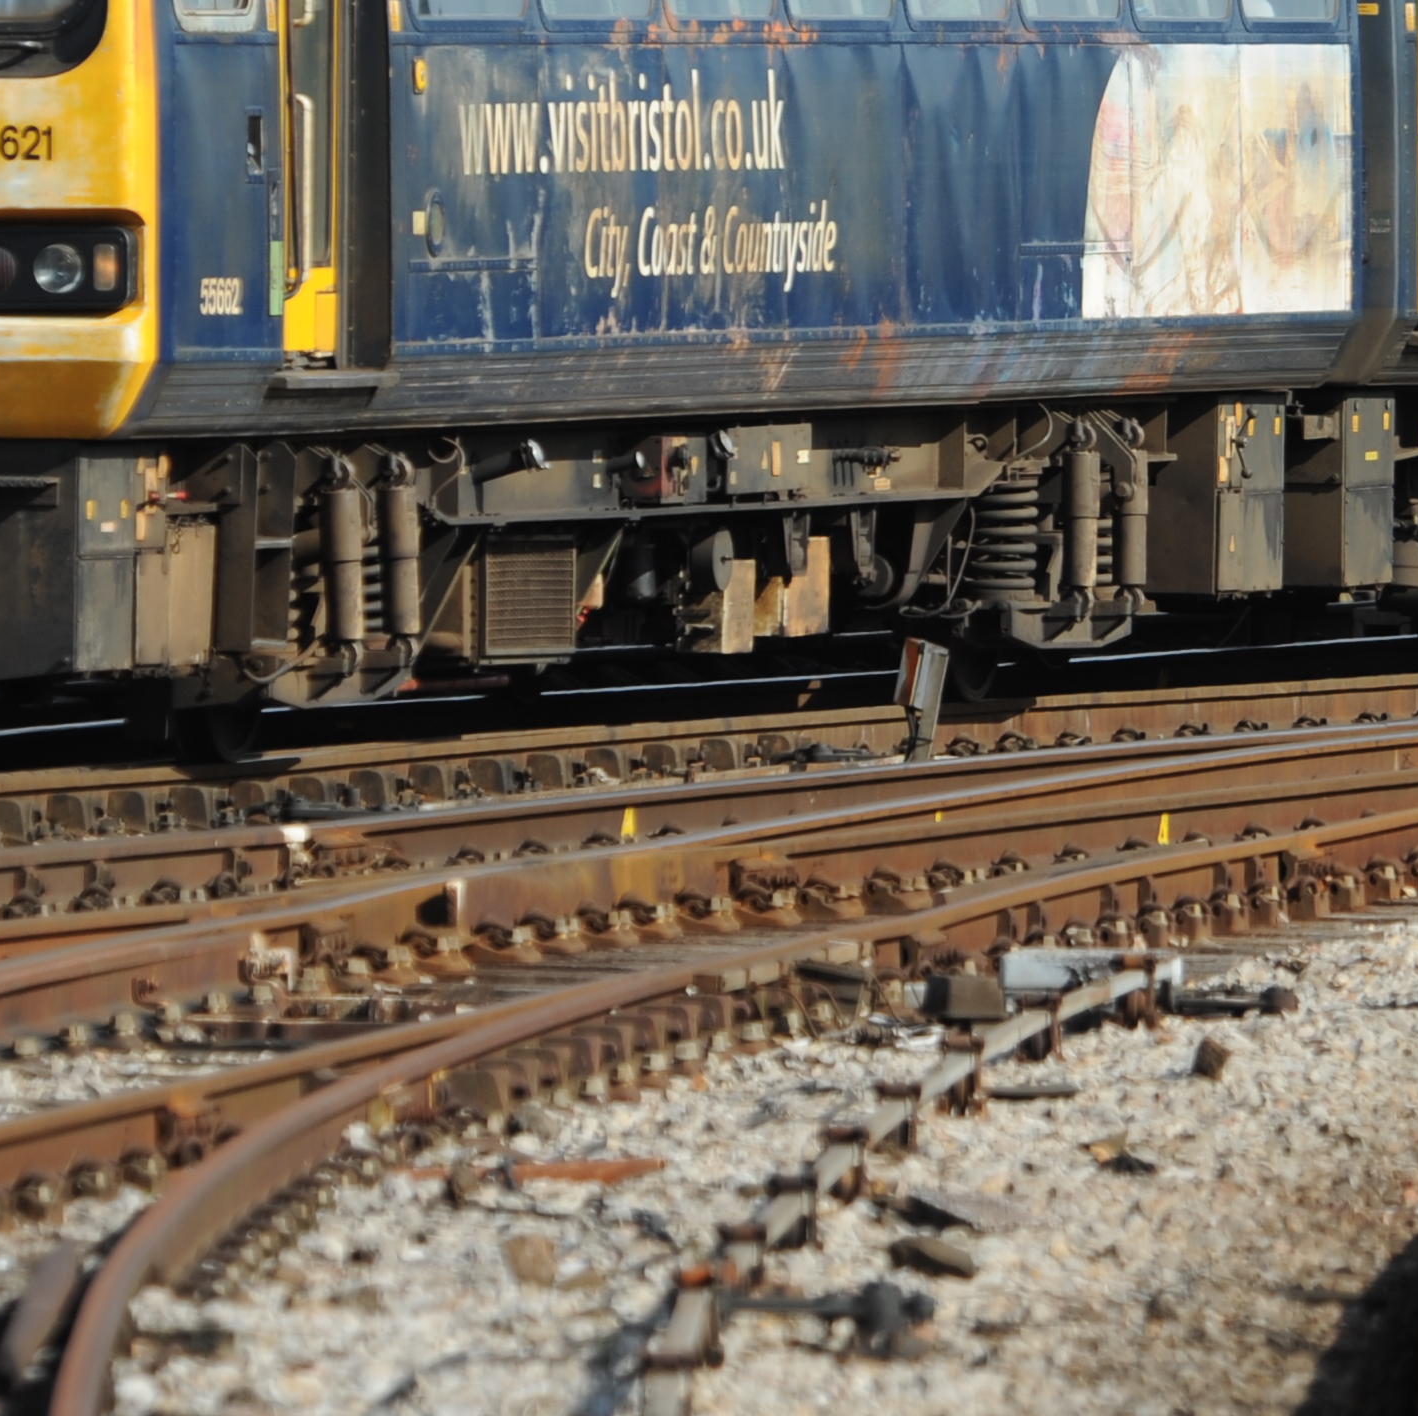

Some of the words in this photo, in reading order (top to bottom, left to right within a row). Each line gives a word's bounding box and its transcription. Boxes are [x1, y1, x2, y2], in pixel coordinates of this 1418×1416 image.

[458, 68, 786, 175] www.visitbristol.co.uk
[199, 277, 243, 315] 55662
[584, 206, 631, 298] City,
[637, 206, 697, 277] Coast
[699, 205, 718, 275] &
[722, 200, 838, 292] Countryside
